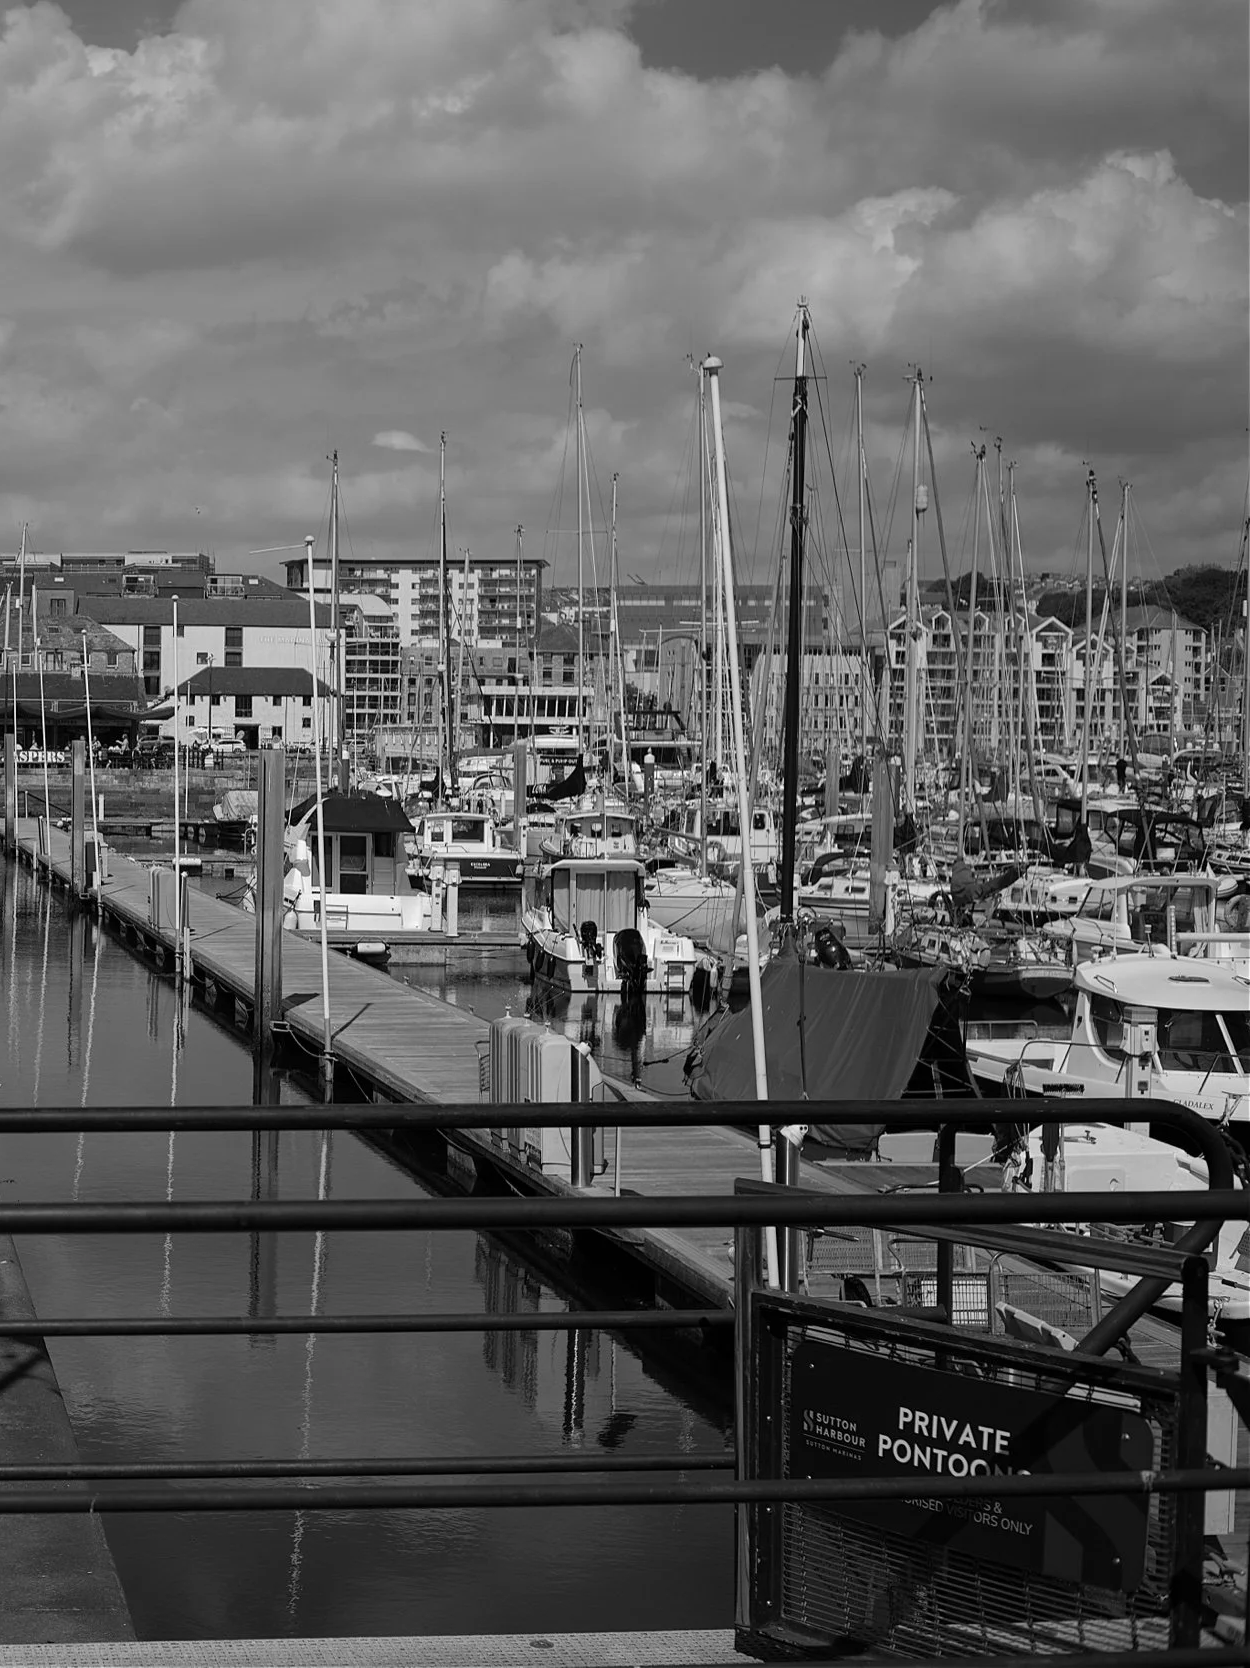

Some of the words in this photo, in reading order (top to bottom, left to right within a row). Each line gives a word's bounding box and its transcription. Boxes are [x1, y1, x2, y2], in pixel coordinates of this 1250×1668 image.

[1, 750, 65, 763] ASPERS
[1173, 1098, 1214, 1110] GLADALEX
[816, 1412, 857, 1433] SUTTON
[898, 1406, 1011, 1456] PRIVATE
[816, 1425, 866, 1448] HARBOUR
[805, 1439, 831, 1452] SUTTON
[832, 1448, 862, 1461] MARINAS
[878, 1433, 1032, 1478] PONTOON
[993, 1501, 1003, 1514] &
[945, 1504, 998, 1527] VISITORS
[1001, 1518, 1033, 1536] ONLY
